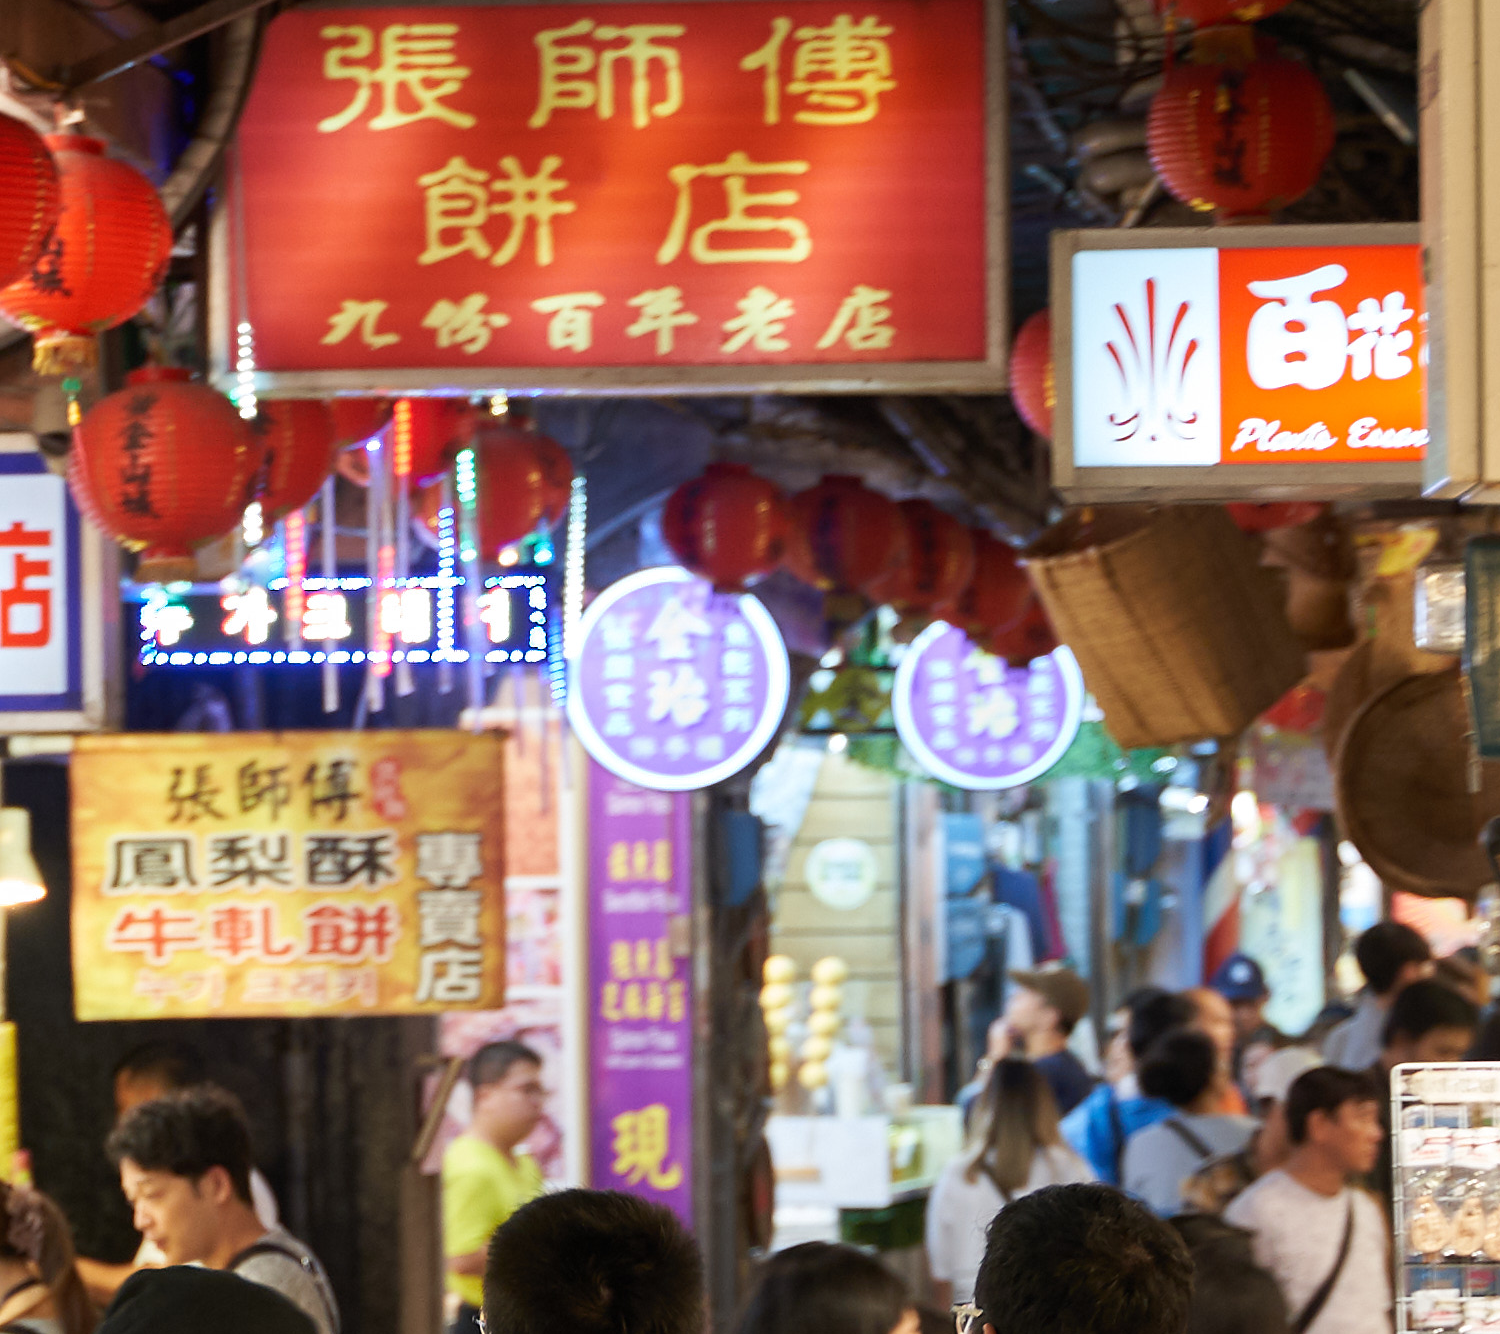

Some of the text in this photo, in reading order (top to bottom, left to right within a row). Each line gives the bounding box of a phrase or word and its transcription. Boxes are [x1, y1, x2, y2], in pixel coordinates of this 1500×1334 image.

[317, 13, 899, 133] 張師傅
[416, 151, 814, 267] 餅店
[319, 284, 899, 355] 九份百年老店
[1245, 264, 1429, 391] 百花
[168, 759, 364, 823] 張師傅
[111, 833, 397, 889] 鳳梨酥
[113, 907, 397, 958] 牛軋餅
[414, 832, 484, 1003] 專賣店
